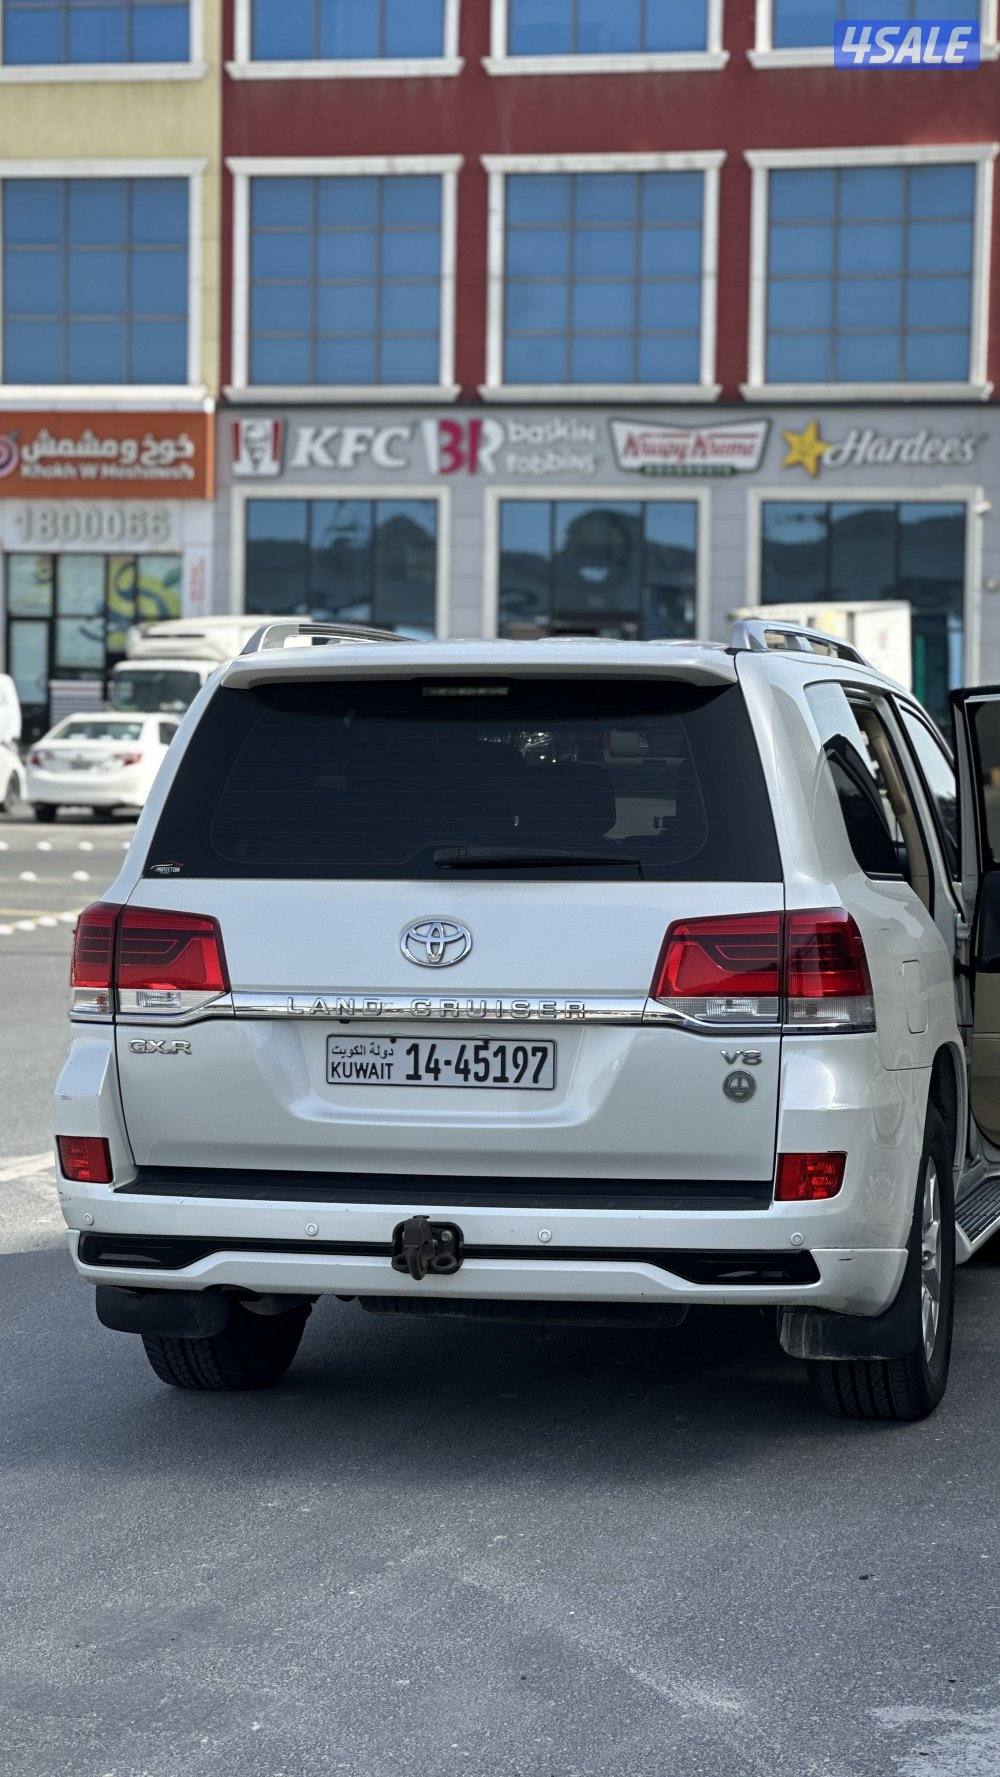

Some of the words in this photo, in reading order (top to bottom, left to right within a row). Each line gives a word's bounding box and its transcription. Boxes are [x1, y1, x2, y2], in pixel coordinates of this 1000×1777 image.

[291, 425, 410, 469] KFC
[286, 996, 384, 1016] LAND
[410, 998, 587, 1020] CRUISER
[128, 1038, 193, 1056] GXR
[331, 1043, 368, 1058] الكويت
[369, 1042, 395, 1059] دولة
[405, 1043, 549, 1084] 14-45197
[720, 1049, 763, 1066] V8
[331, 1061, 394, 1080] KUWAIT
